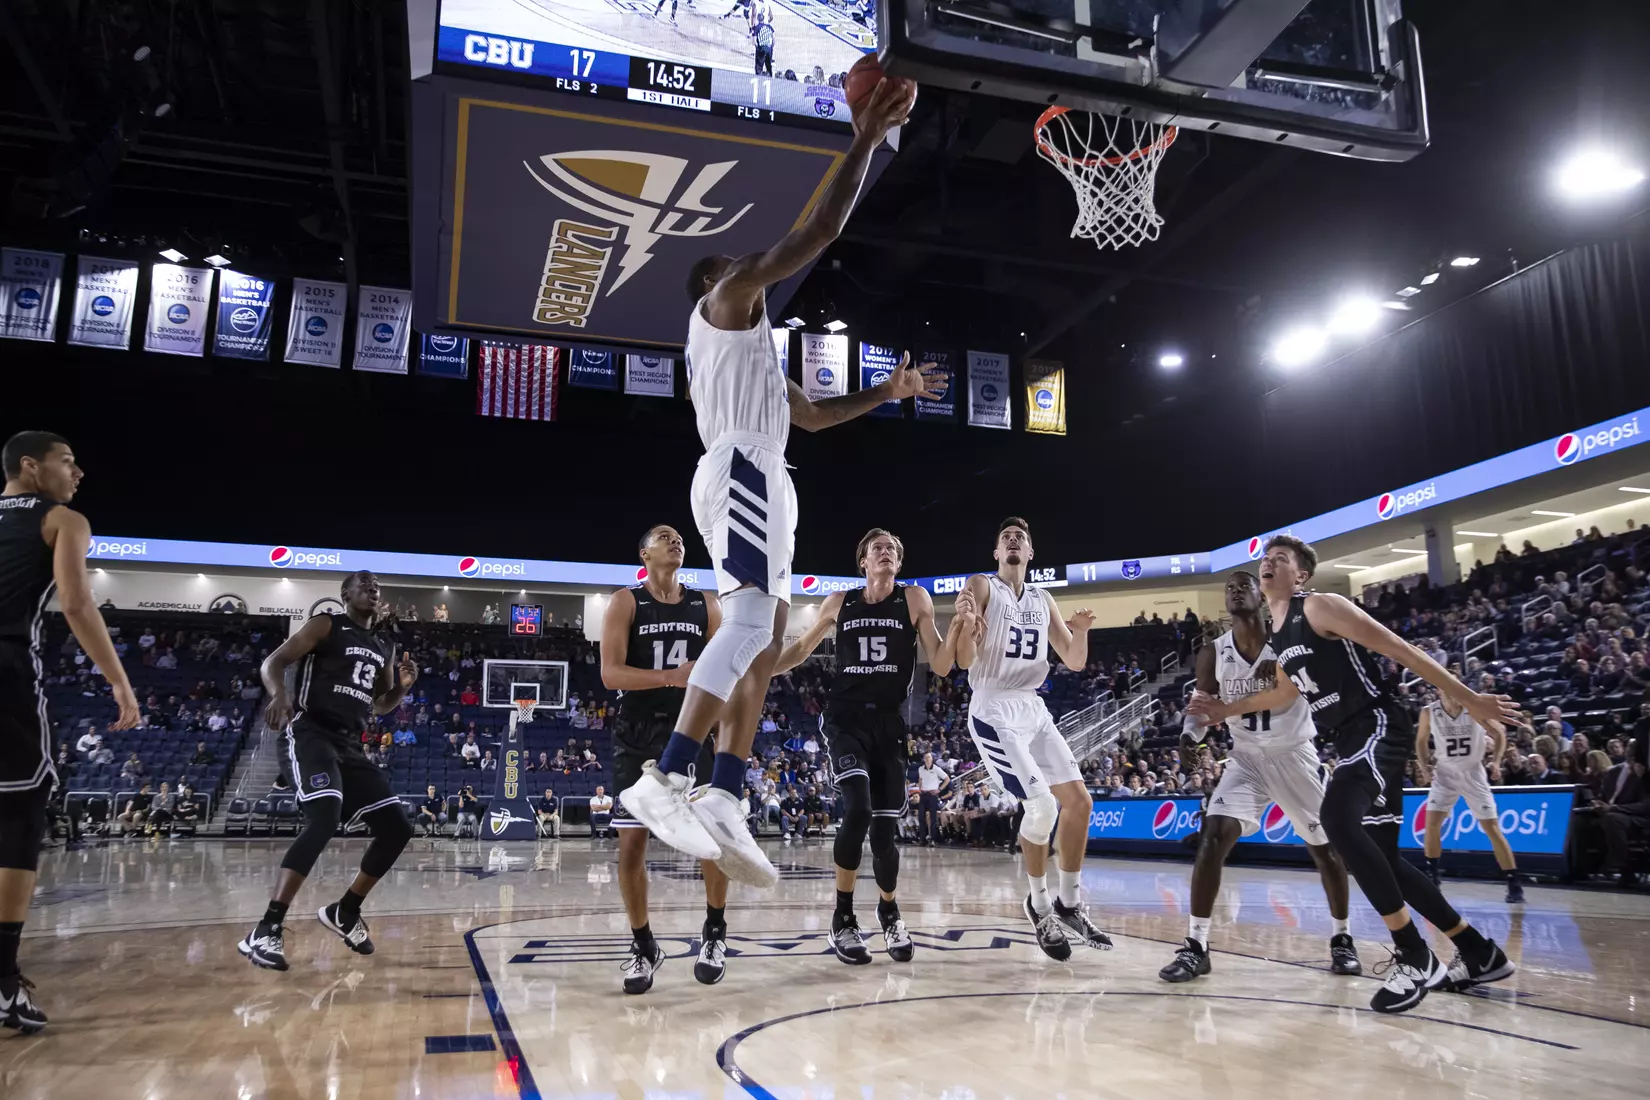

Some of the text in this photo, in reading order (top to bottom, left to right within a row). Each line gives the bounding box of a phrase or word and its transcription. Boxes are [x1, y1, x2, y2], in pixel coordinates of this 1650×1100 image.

[464, 33, 535, 69] CBU
[569, 49, 596, 78] 17
[647, 61, 696, 92] 14:52
[556, 77, 598, 94] FLS 2
[750, 77, 771, 106] 11
[643, 91, 664, 103] 1ST
[737, 105, 775, 121] FLS 1
[532, 219, 619, 328] LANCERS
[232, 290, 260, 299] MEN'S
[304, 286, 336, 298] 2015
[370, 293, 401, 304] 2014
[305, 298, 331, 307] MEN'S
[294, 304, 343, 316] BASKETBALL
[371, 305, 396, 314] MEN'S
[73, 325, 128, 336] TOURNAMENT
[149, 331, 202, 343] TOURNAMENT
[157, 326, 191, 335] DIVISION
[292, 337, 330, 348] DIVISION
[294, 346, 333, 357] SWEET 16
[357, 351, 405, 361] TOURNAMENT
[364, 345, 394, 354] DIVISION
[869, 344, 894, 356] 2017
[923, 351, 948, 361] 2017
[419, 353, 466, 364] CHAMPIONS
[864, 354, 897, 364] WOMEN'S
[976, 357, 1001, 368] 2017
[571, 364, 616, 375] CHAMPIONS
[629, 369, 672, 379] WEST REGION
[630, 376, 669, 385] CHAMPIONS
[919, 407, 954, 416] CHAMPIONS
[1583, 417, 1640, 455] pepsi
[1396, 483, 1437, 513] pepsi
[96, 541, 147, 557] pepsi
[294, 551, 342, 568] pepsi
[481, 561, 527, 577] pepsi
[1028, 567, 1056, 582] 14:52
[1082, 564, 1097, 582] 11
[933, 576, 967, 594] CBU
[137, 601, 202, 610] ACADEMICALLY
[259, 606, 304, 615] BIBLICALLY
[1004, 604, 1042, 625] LANCERS
[515, 616, 536, 633] 26
[638, 621, 702, 636] CENTRAL
[843, 618, 903, 632] CENTRAL
[858, 636, 887, 662] 15
[1005, 625, 1039, 660] 33
[345, 646, 385, 668] CENTRAL
[652, 639, 689, 671] 14
[352, 660, 376, 690] 13
[843, 664, 898, 675] ARKANSAS
[1446, 736, 1471, 757] 25
[504, 749, 519, 799] CBU
